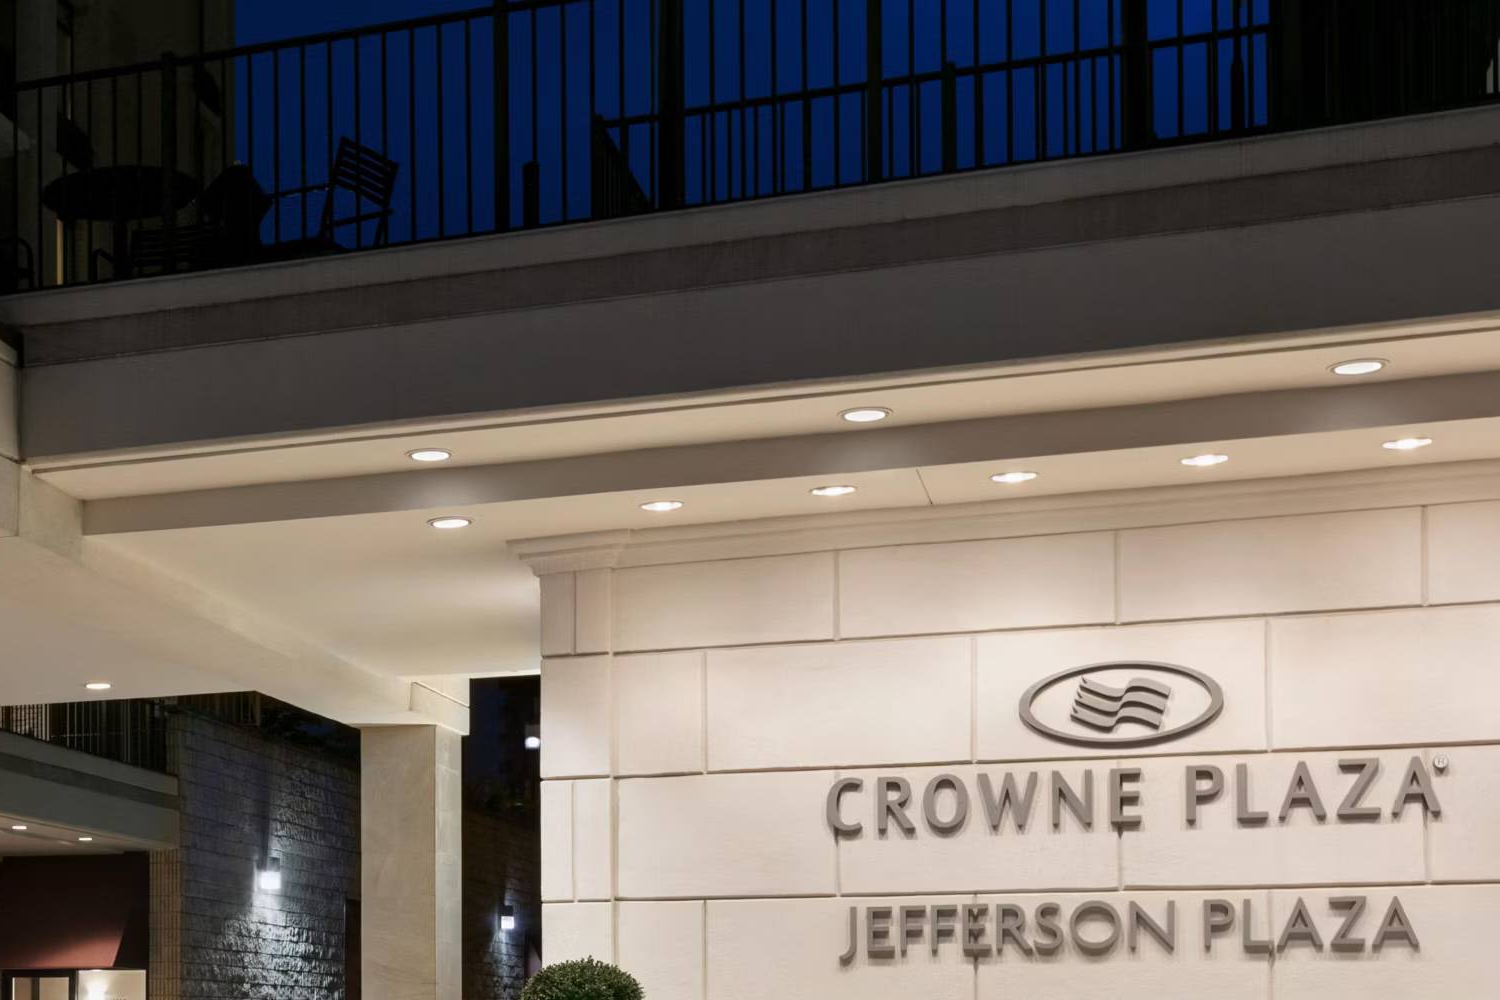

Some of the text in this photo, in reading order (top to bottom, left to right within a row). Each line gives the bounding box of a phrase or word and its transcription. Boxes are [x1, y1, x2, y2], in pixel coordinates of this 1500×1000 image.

[825, 756, 1441, 836] CROWNE PLAZA
[839, 895, 1420, 964] JEFFERSON PLAZA
